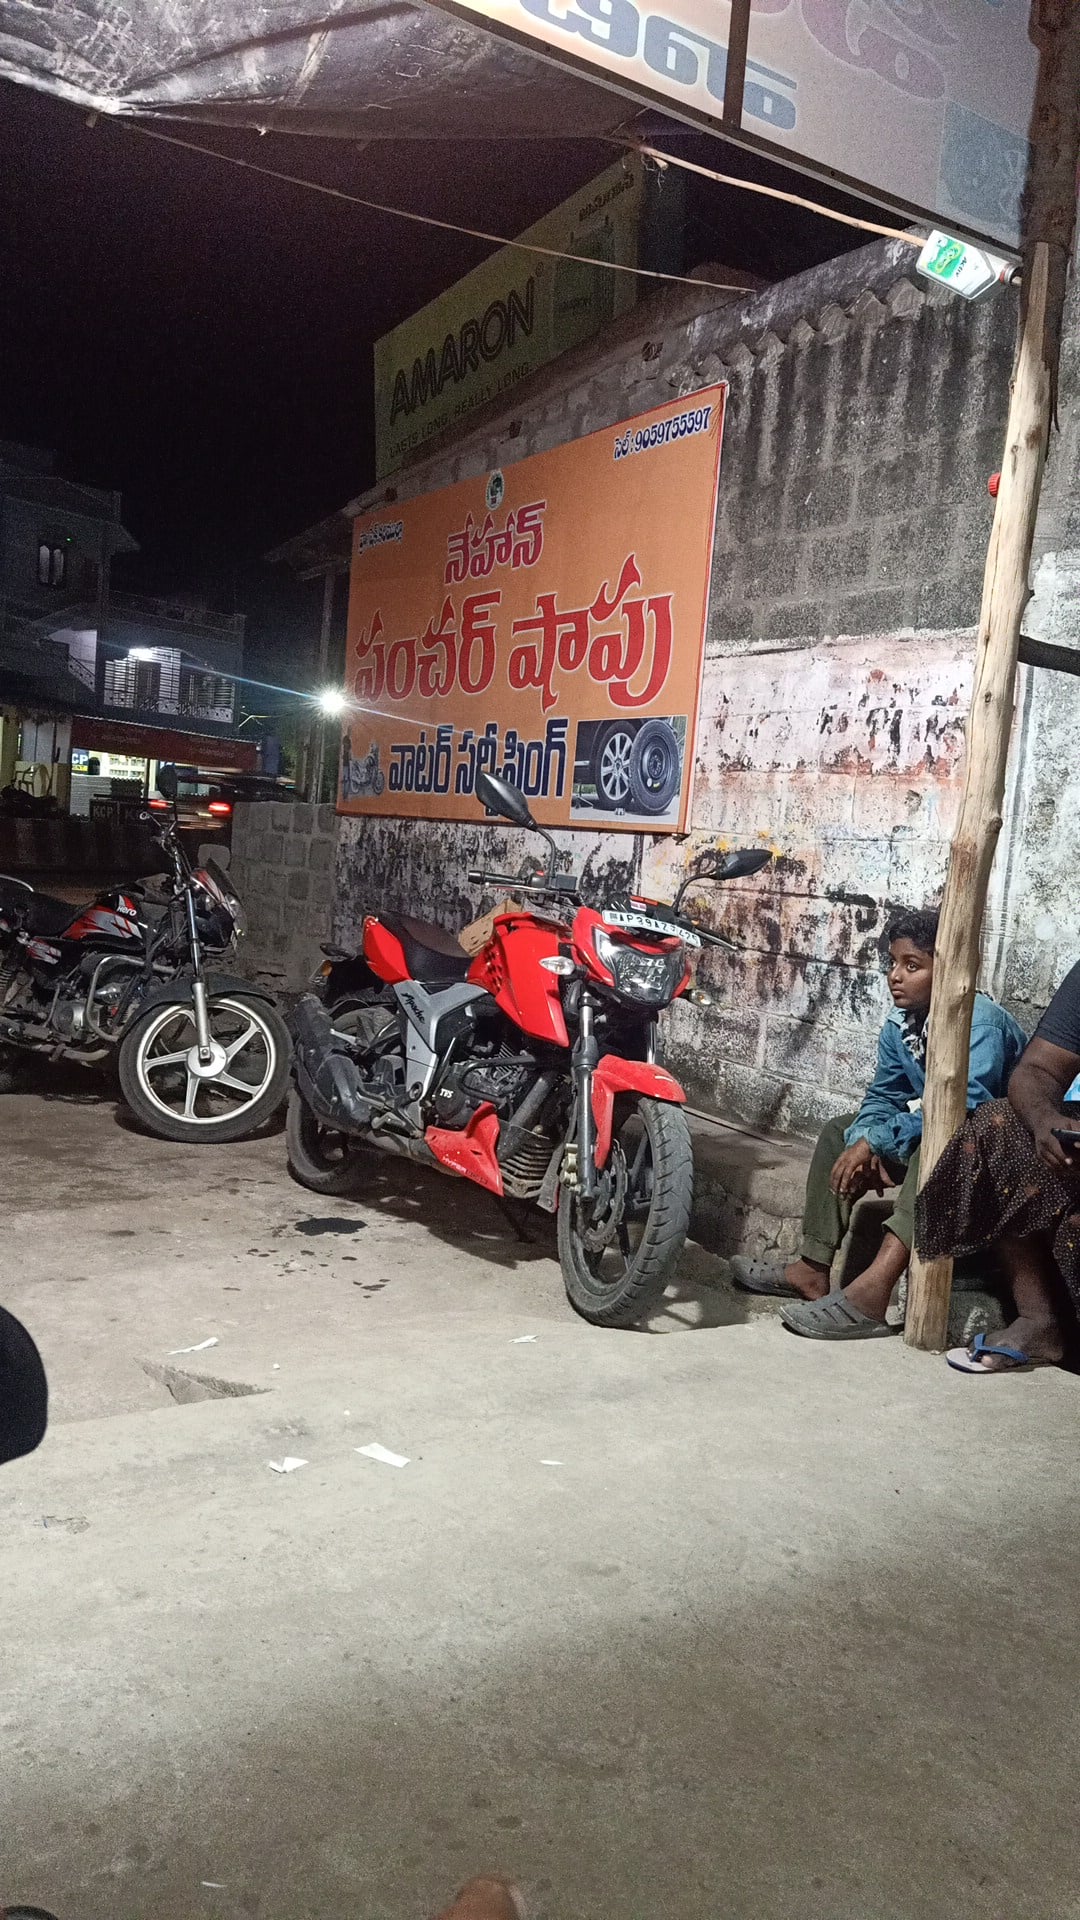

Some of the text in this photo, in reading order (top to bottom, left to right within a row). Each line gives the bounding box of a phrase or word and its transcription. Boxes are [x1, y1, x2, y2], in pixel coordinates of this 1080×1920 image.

[389, 275, 535, 424] AMARON
[355, 552, 673, 712] పంచర్ షాపు
[71, 753, 89, 765] CP
[388, 725, 453, 793] వాటర్
[117, 906, 137, 917] Hero
[401, 991, 425, 1025] Apache
[440, 1088, 454, 1099] TVS
